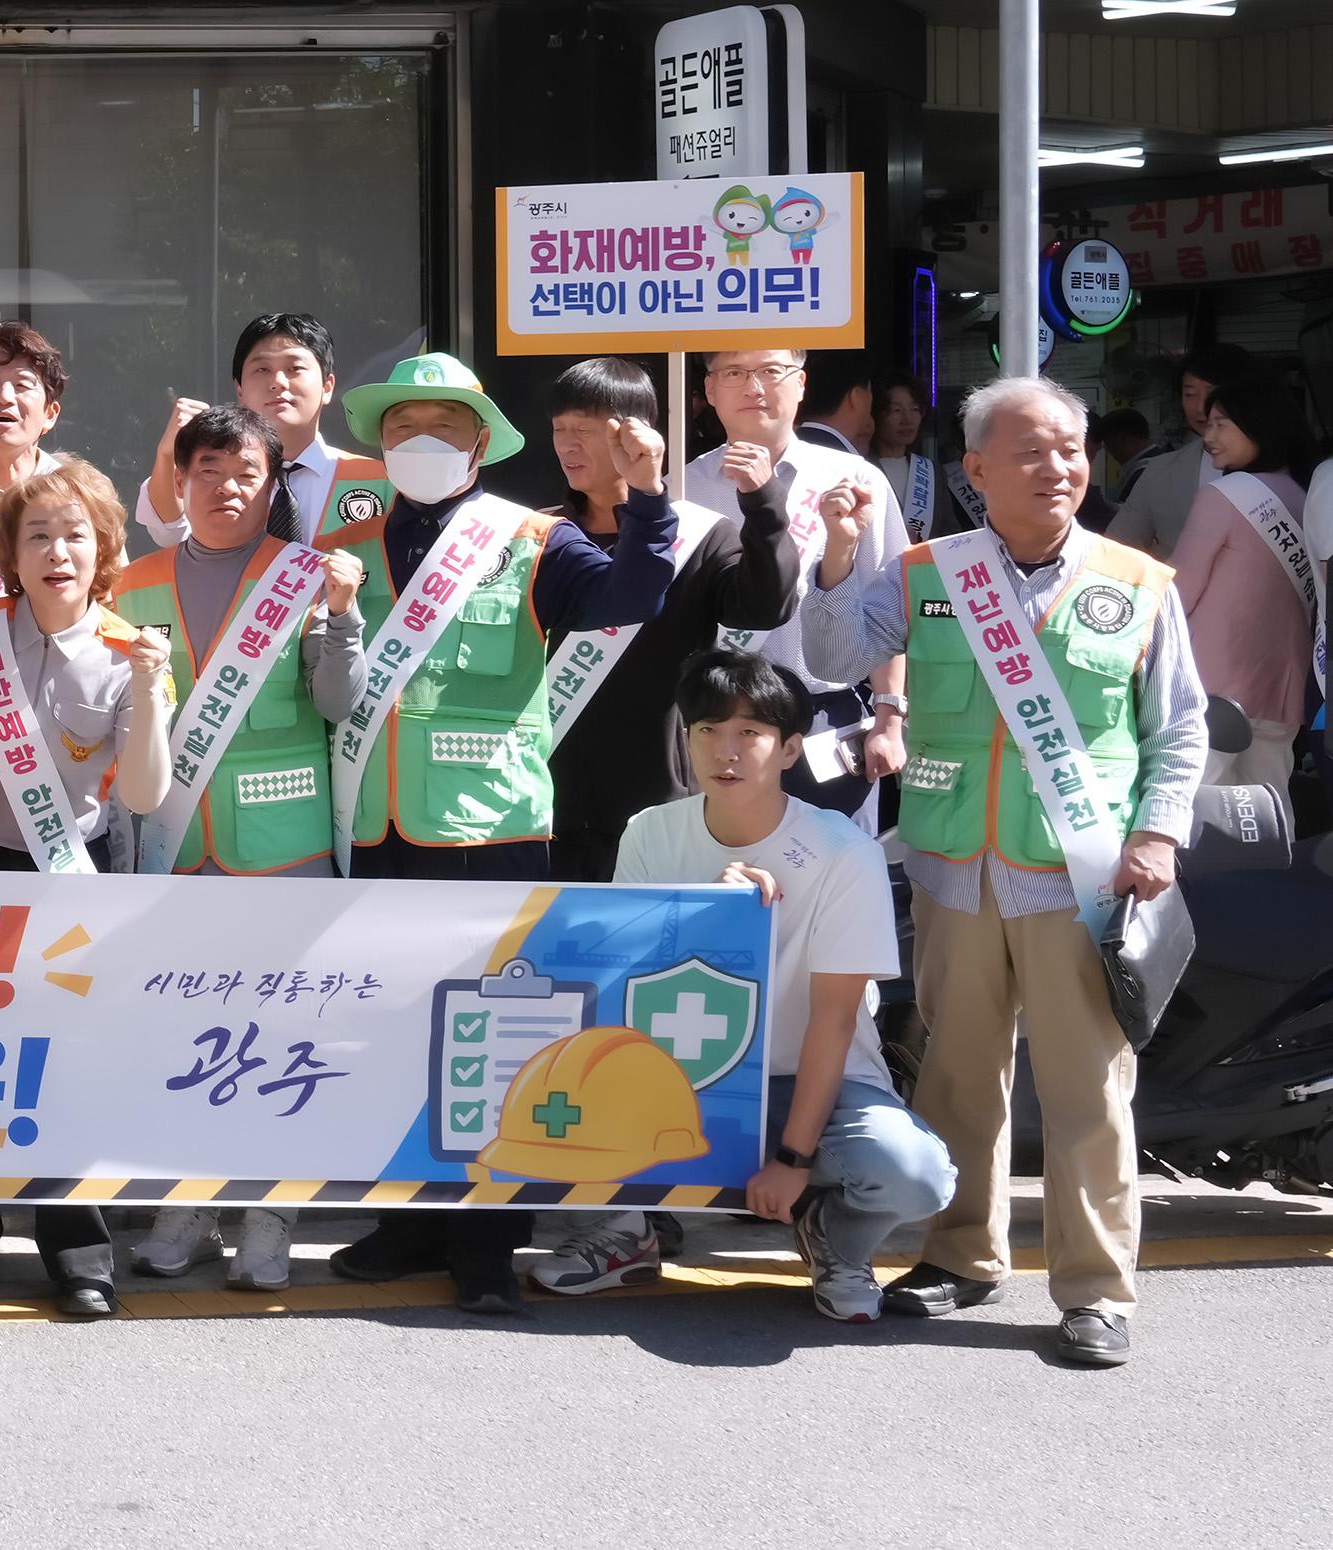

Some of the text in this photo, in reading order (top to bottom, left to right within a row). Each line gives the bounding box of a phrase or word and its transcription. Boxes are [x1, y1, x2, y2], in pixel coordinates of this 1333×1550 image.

[659, 42, 744, 119] 골든애플
[670, 126, 735, 164] 패션쥬얼리
[528, 202, 567, 216] 광주시
[529, 225, 715, 274] 화재예방,
[529, 267, 820, 317] 선택이 아닌 의무!
[1070, 271, 1120, 291] 골든애플
[924, 602, 956, 616] 광주시
[172, 548, 325, 789] 재난예방 안전실천
[341, 518, 495, 764] 재난예방 안전실천
[551, 640, 605, 726] 안전
[955, 561, 1100, 832] 재난예방 안전실천
[21, 783, 77, 874] 안전실
[1233, 786, 1259, 842] EDENS
[144, 969, 384, 1018] 시민과 직통하는
[165, 1021, 351, 1117] 광주
